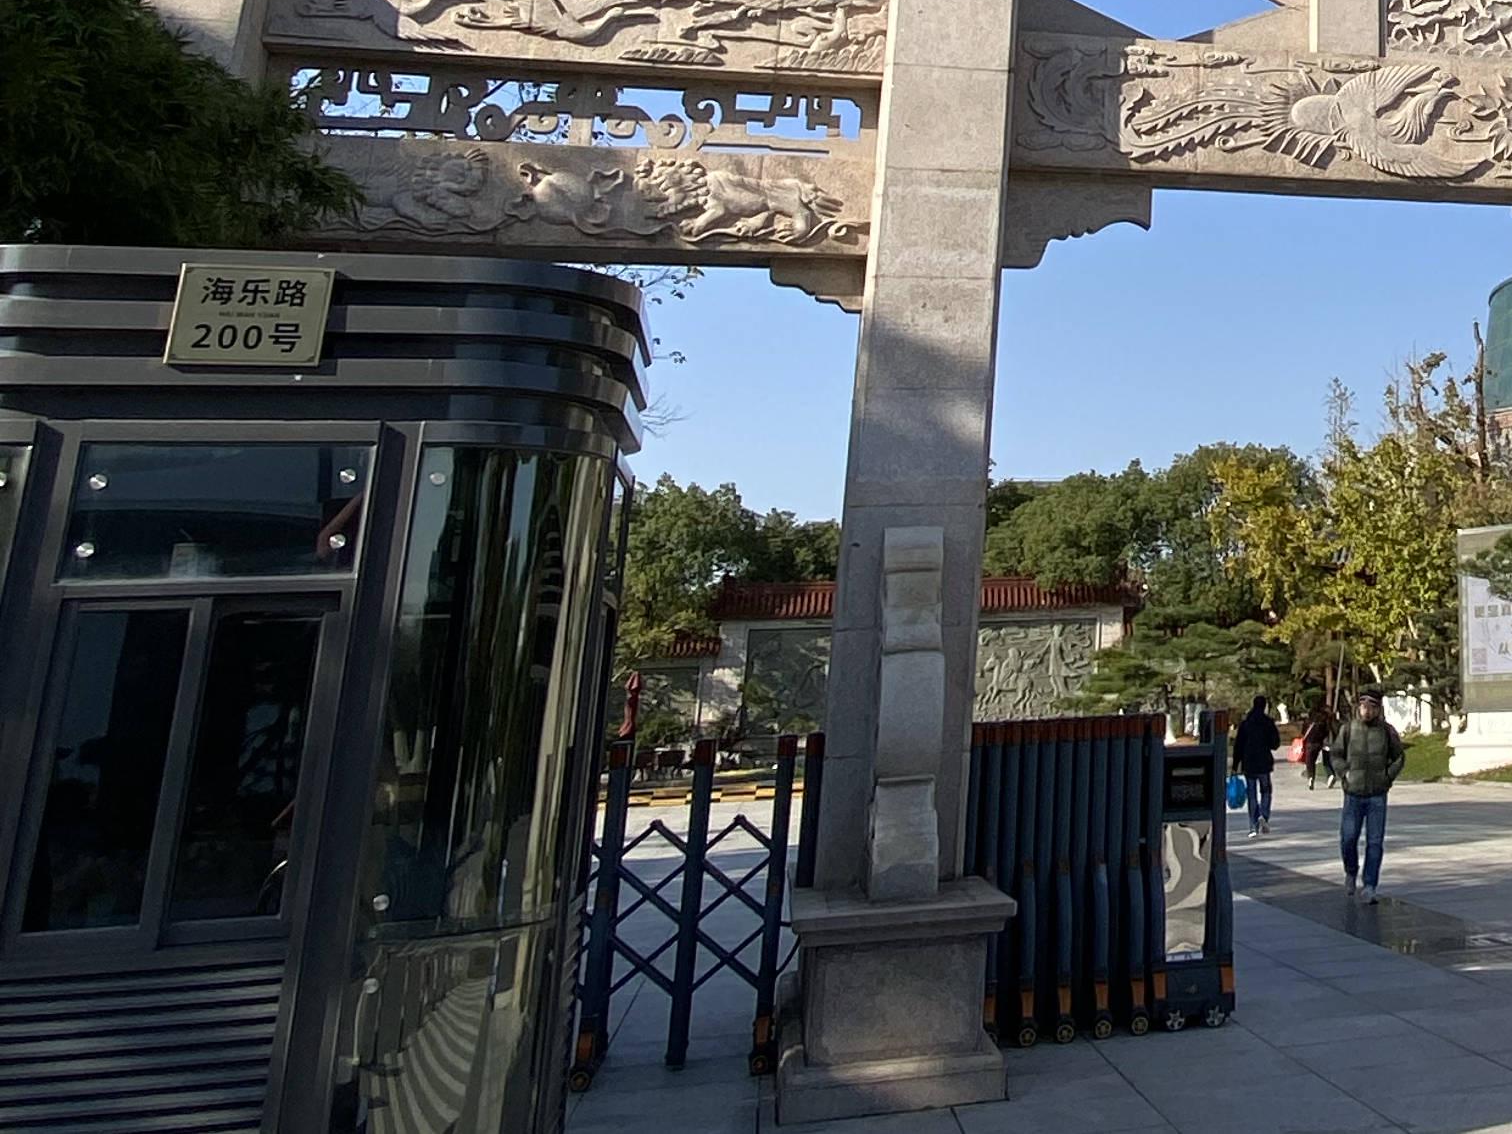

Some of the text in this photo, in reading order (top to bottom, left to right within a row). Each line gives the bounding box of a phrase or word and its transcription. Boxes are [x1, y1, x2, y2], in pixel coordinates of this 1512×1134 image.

[201, 277, 307, 307] 海乐路
[191, 323, 302, 353] 200号
